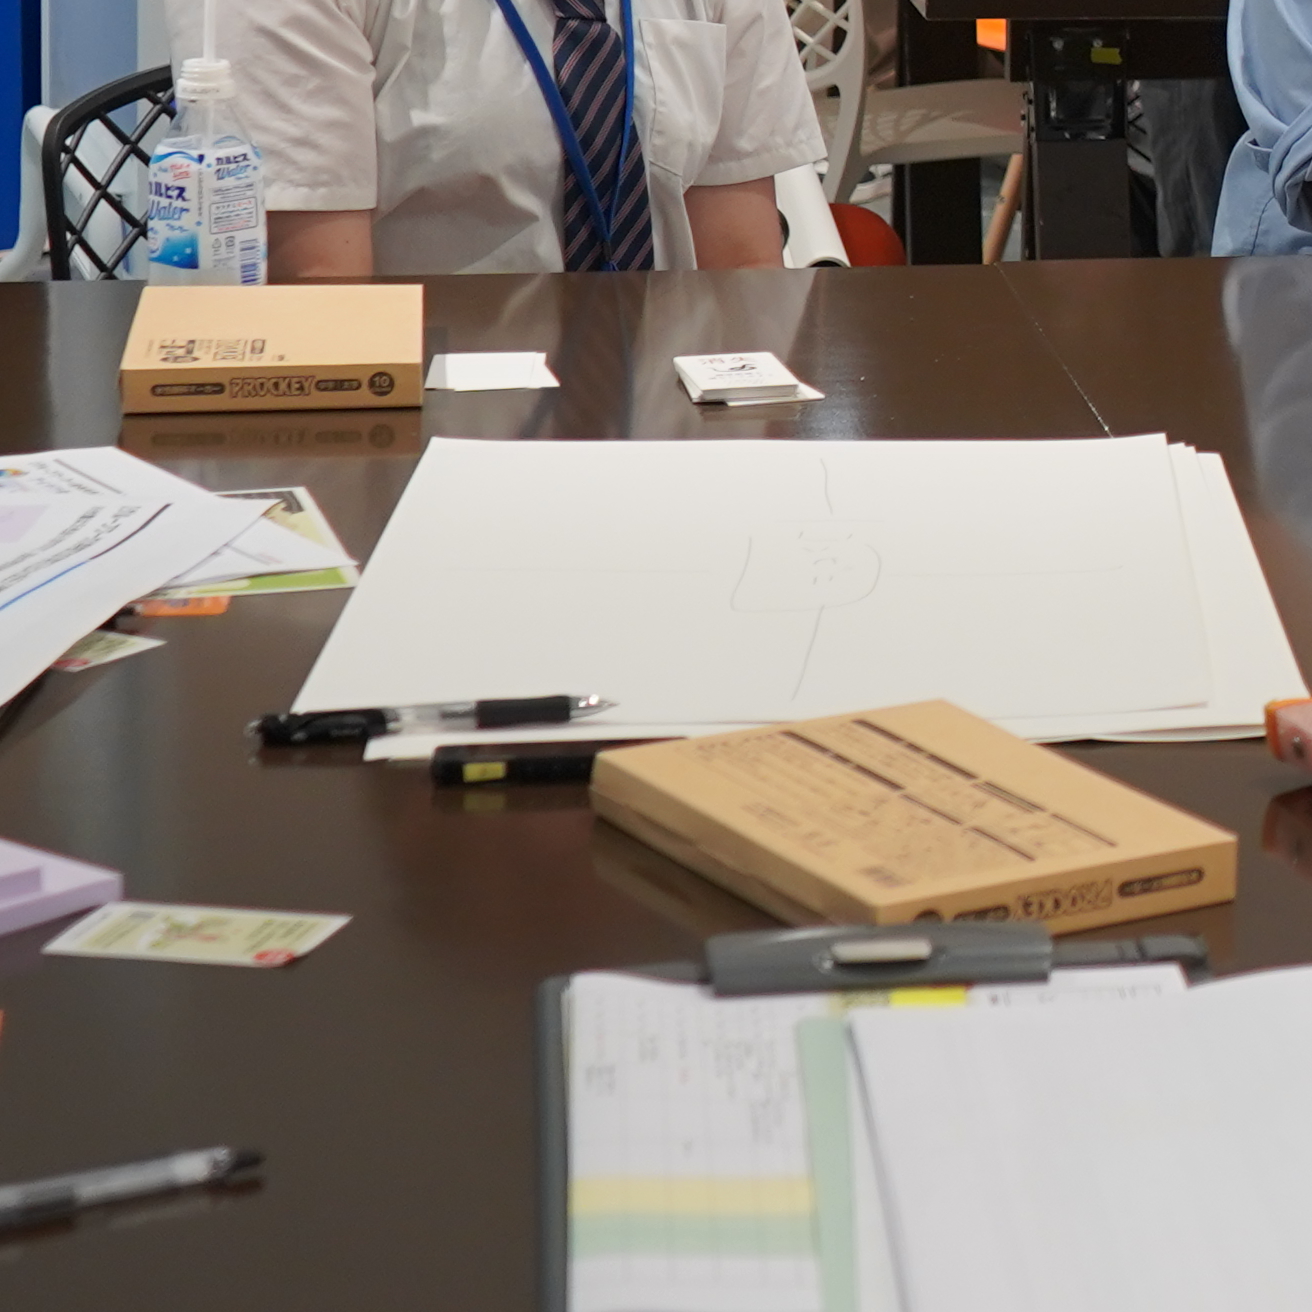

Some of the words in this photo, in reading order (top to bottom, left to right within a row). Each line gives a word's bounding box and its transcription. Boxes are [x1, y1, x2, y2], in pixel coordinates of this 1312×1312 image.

[215, 153, 251, 166] カルピス
[229, 375, 315, 398] PROCKEY
[374, 376, 388, 386] 10
